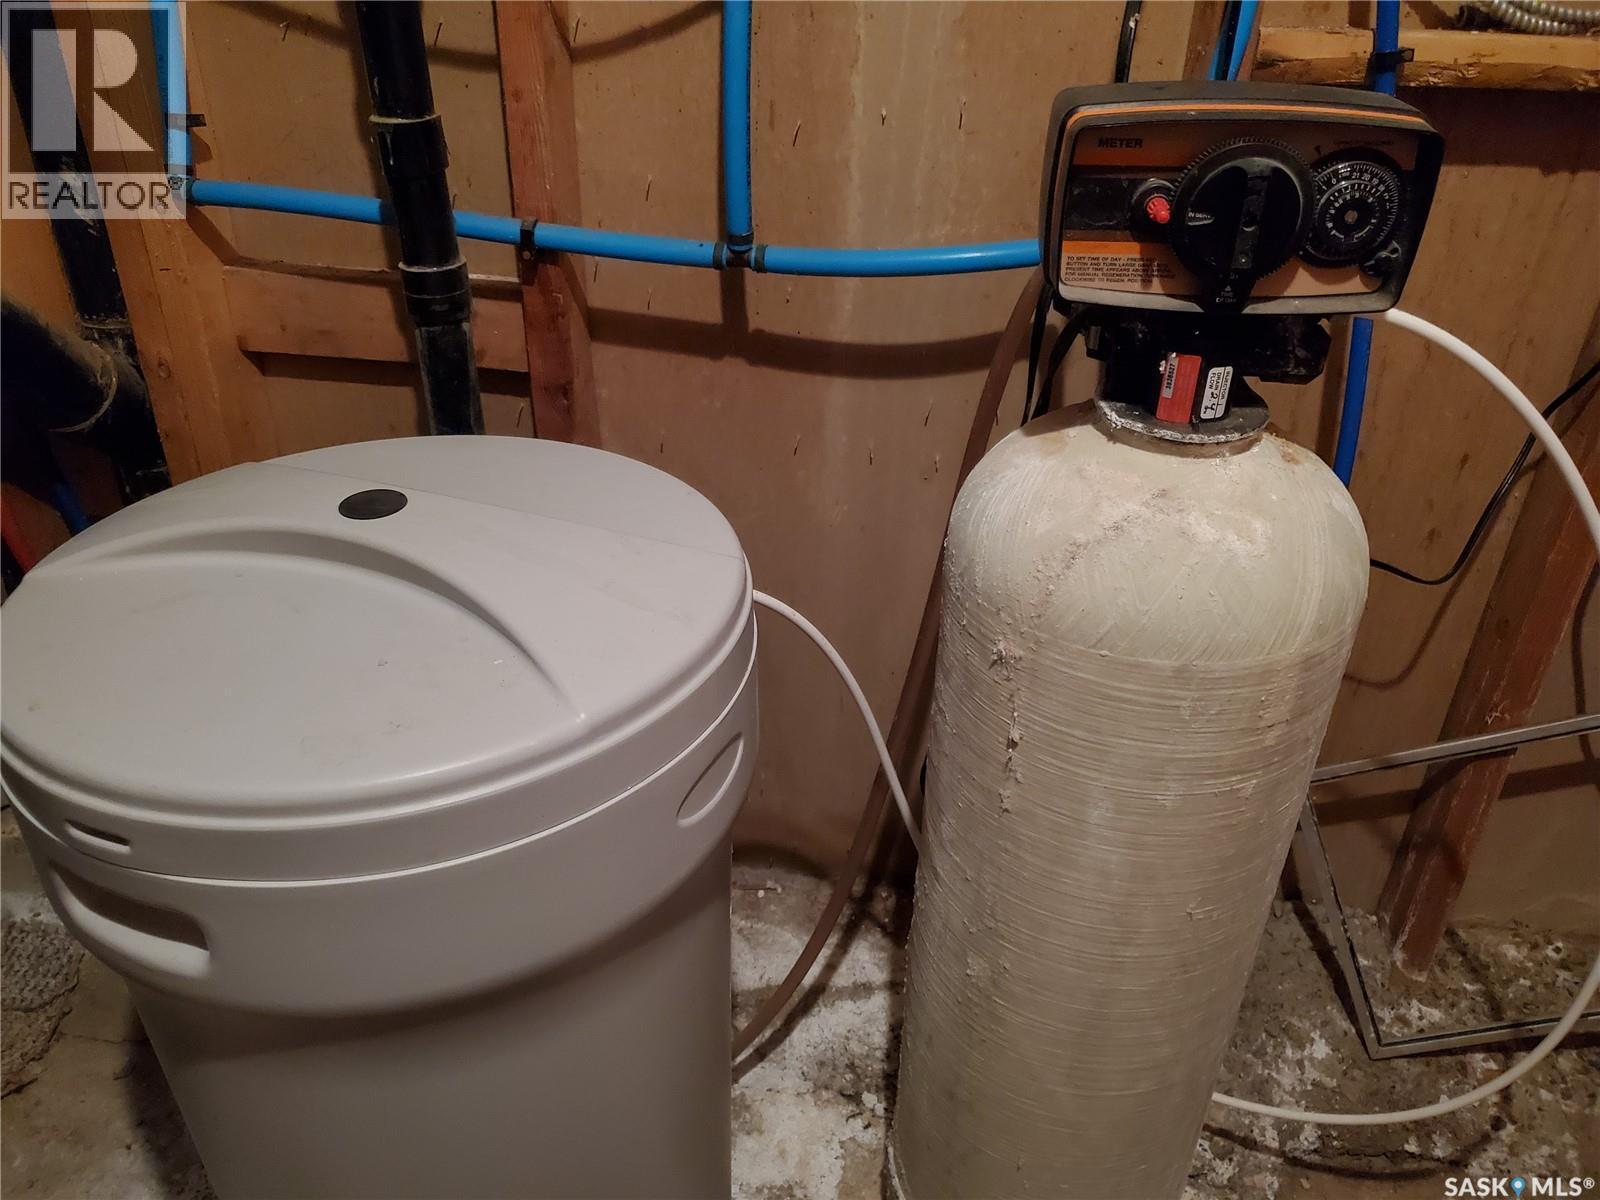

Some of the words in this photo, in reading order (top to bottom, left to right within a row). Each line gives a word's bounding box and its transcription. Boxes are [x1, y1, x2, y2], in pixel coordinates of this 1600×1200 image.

[1098, 138, 1143, 148] METER
[1208, 372, 1217, 390] FLOW
[1213, 371, 1222, 391] DRAIN
[1220, 370, 1231, 400] INJECTOR
